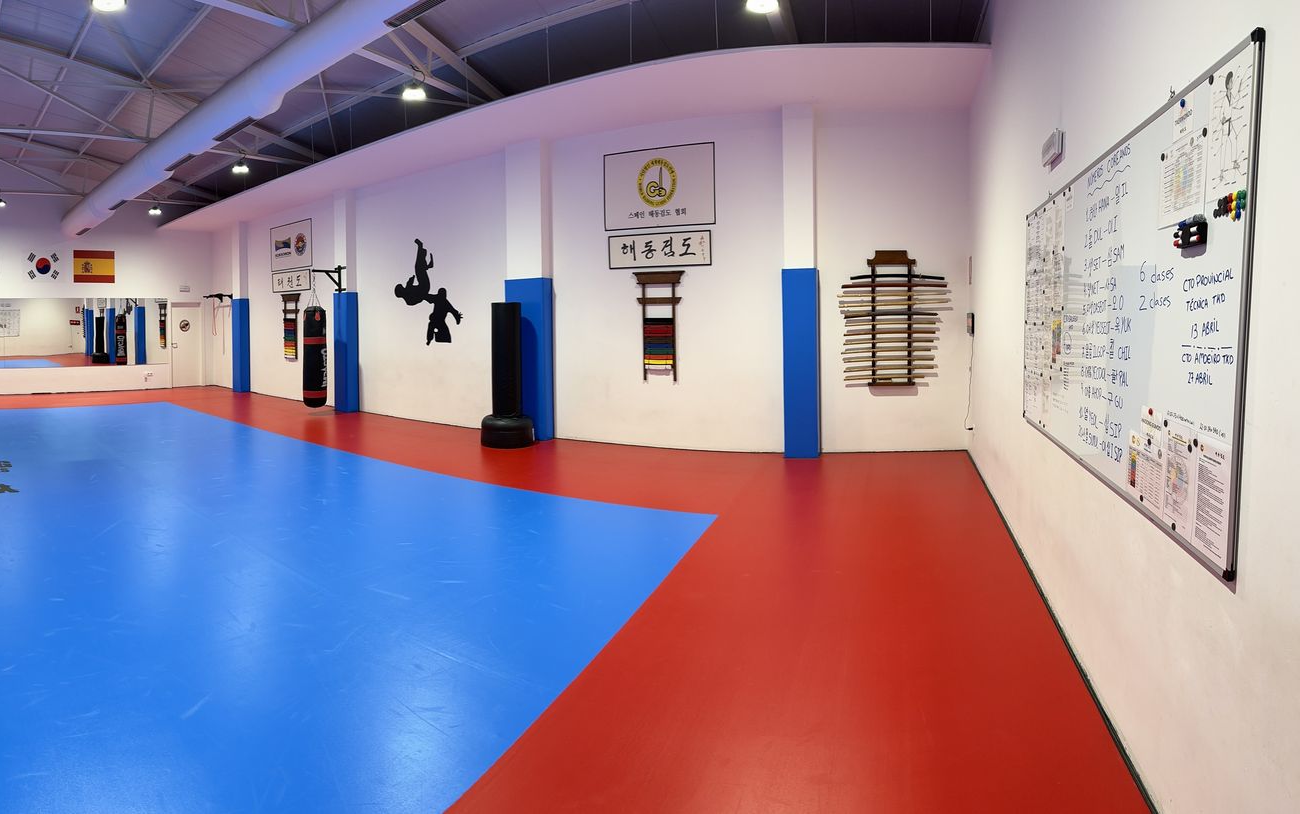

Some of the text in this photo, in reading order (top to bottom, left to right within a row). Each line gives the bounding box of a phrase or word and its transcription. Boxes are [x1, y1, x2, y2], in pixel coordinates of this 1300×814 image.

[1139, 260, 1147, 282] 6
[1182, 268, 1234, 292] CTO PROVINCIAL
[1139, 291, 1172, 311] 2 clases
[1190, 317, 1219, 340] 13 ABRIL
[1181, 353, 1192, 363] CTO
[1195, 369, 1213, 386] ABRIL
